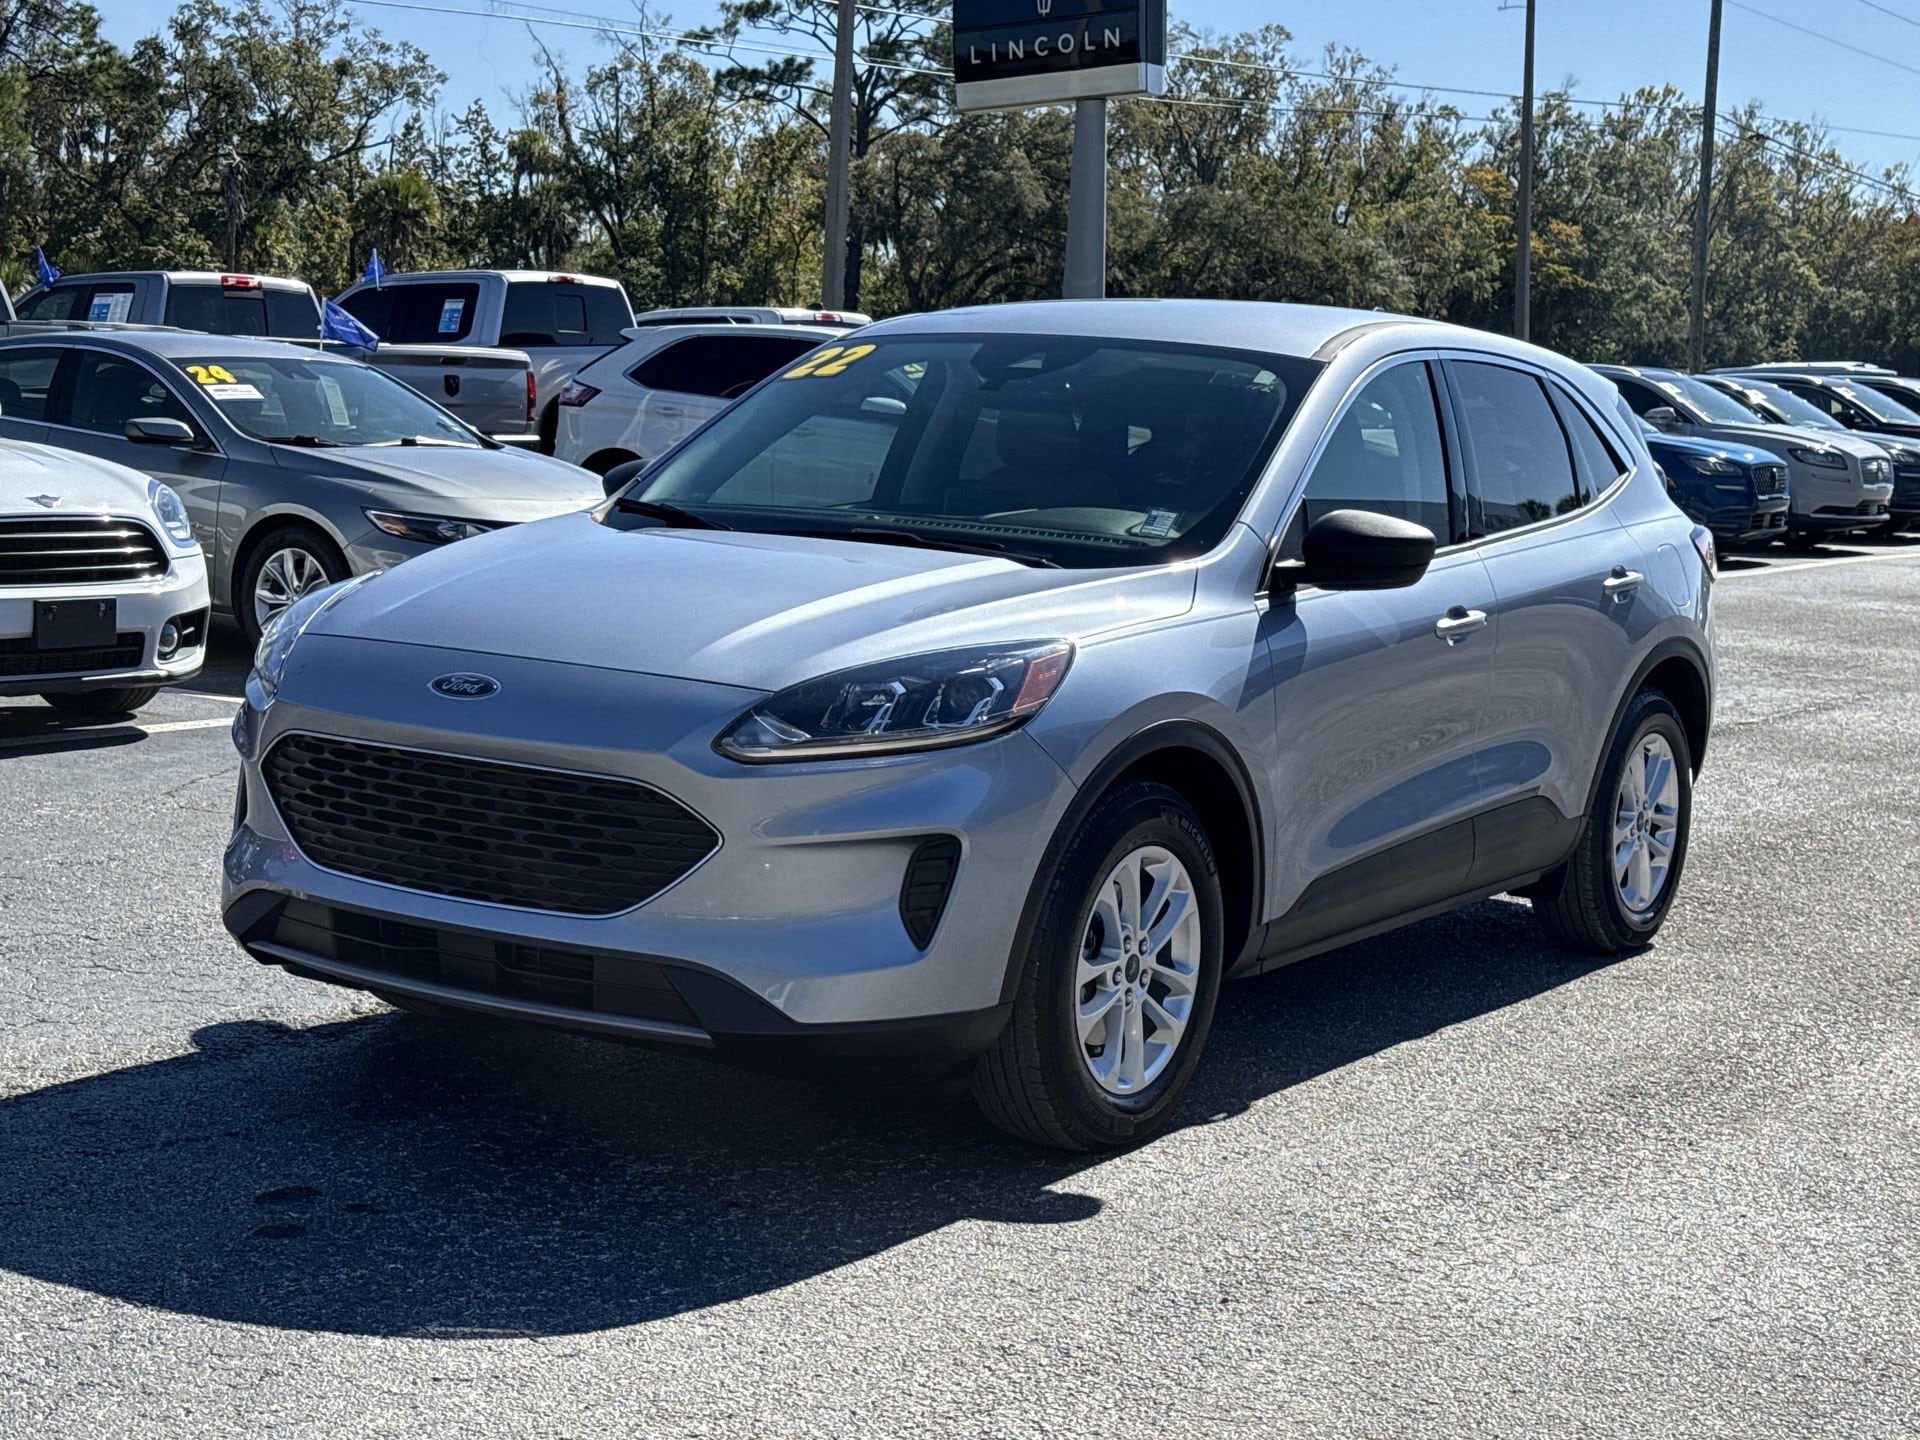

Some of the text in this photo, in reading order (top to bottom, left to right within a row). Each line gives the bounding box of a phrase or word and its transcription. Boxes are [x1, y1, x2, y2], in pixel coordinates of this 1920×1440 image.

[970, 27, 1121, 65] LINCOLN
[782, 344, 876, 379] 22
[442, 675, 485, 694] Ford
[1180, 816, 1216, 874] MICHELIN
